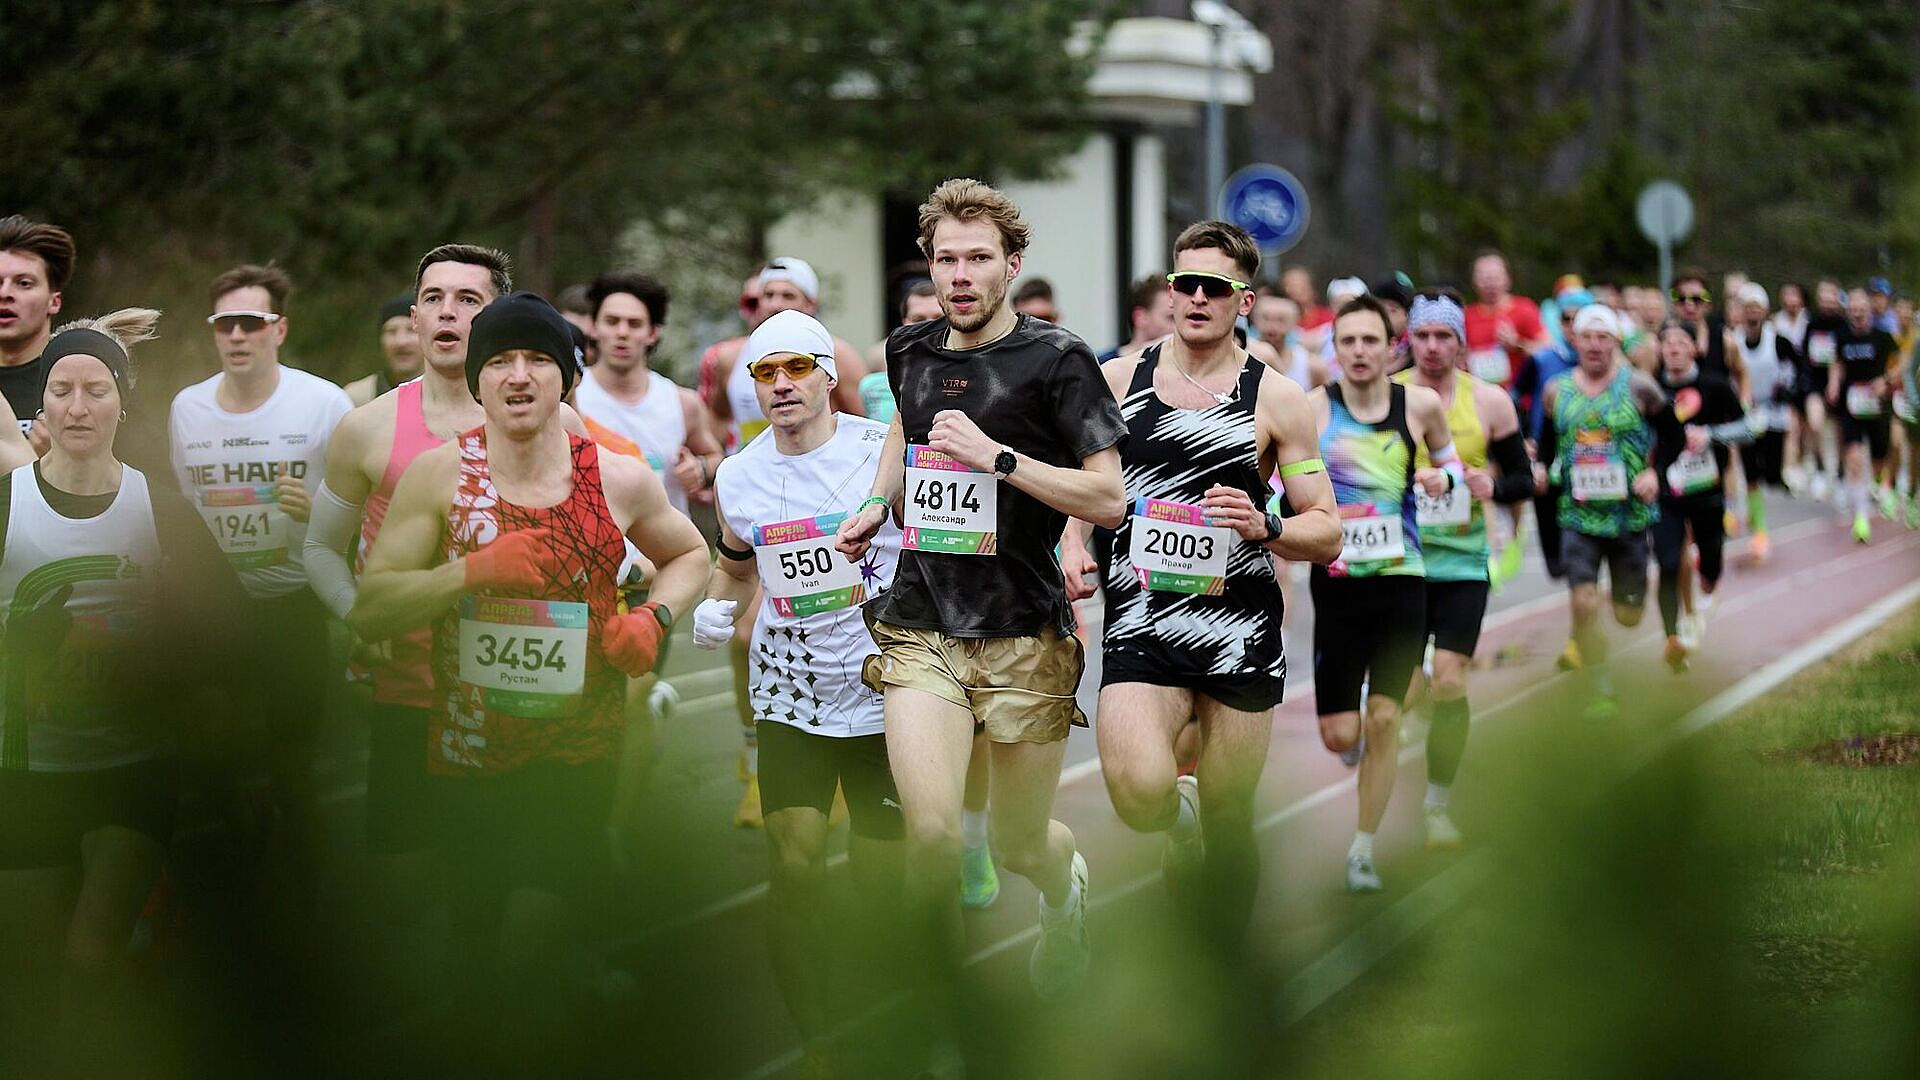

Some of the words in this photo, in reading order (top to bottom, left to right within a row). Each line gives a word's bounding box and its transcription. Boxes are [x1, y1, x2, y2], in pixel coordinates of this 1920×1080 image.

[914, 480, 980, 513] 4814
[1150, 503, 1191, 517] АПРЕЛЬ
[214, 513, 270, 538] 1941
[921, 512, 966, 526] Александр
[765, 524, 806, 538] АПРЕЛЬ
[1144, 529, 1214, 560] 2003
[779, 547, 832, 579] 550
[801, 579, 819, 589] Ivan
[480, 602, 534, 615] АПРЕЛЬ
[475, 634, 567, 672] 3454
[500, 672, 538, 685] Рустам
